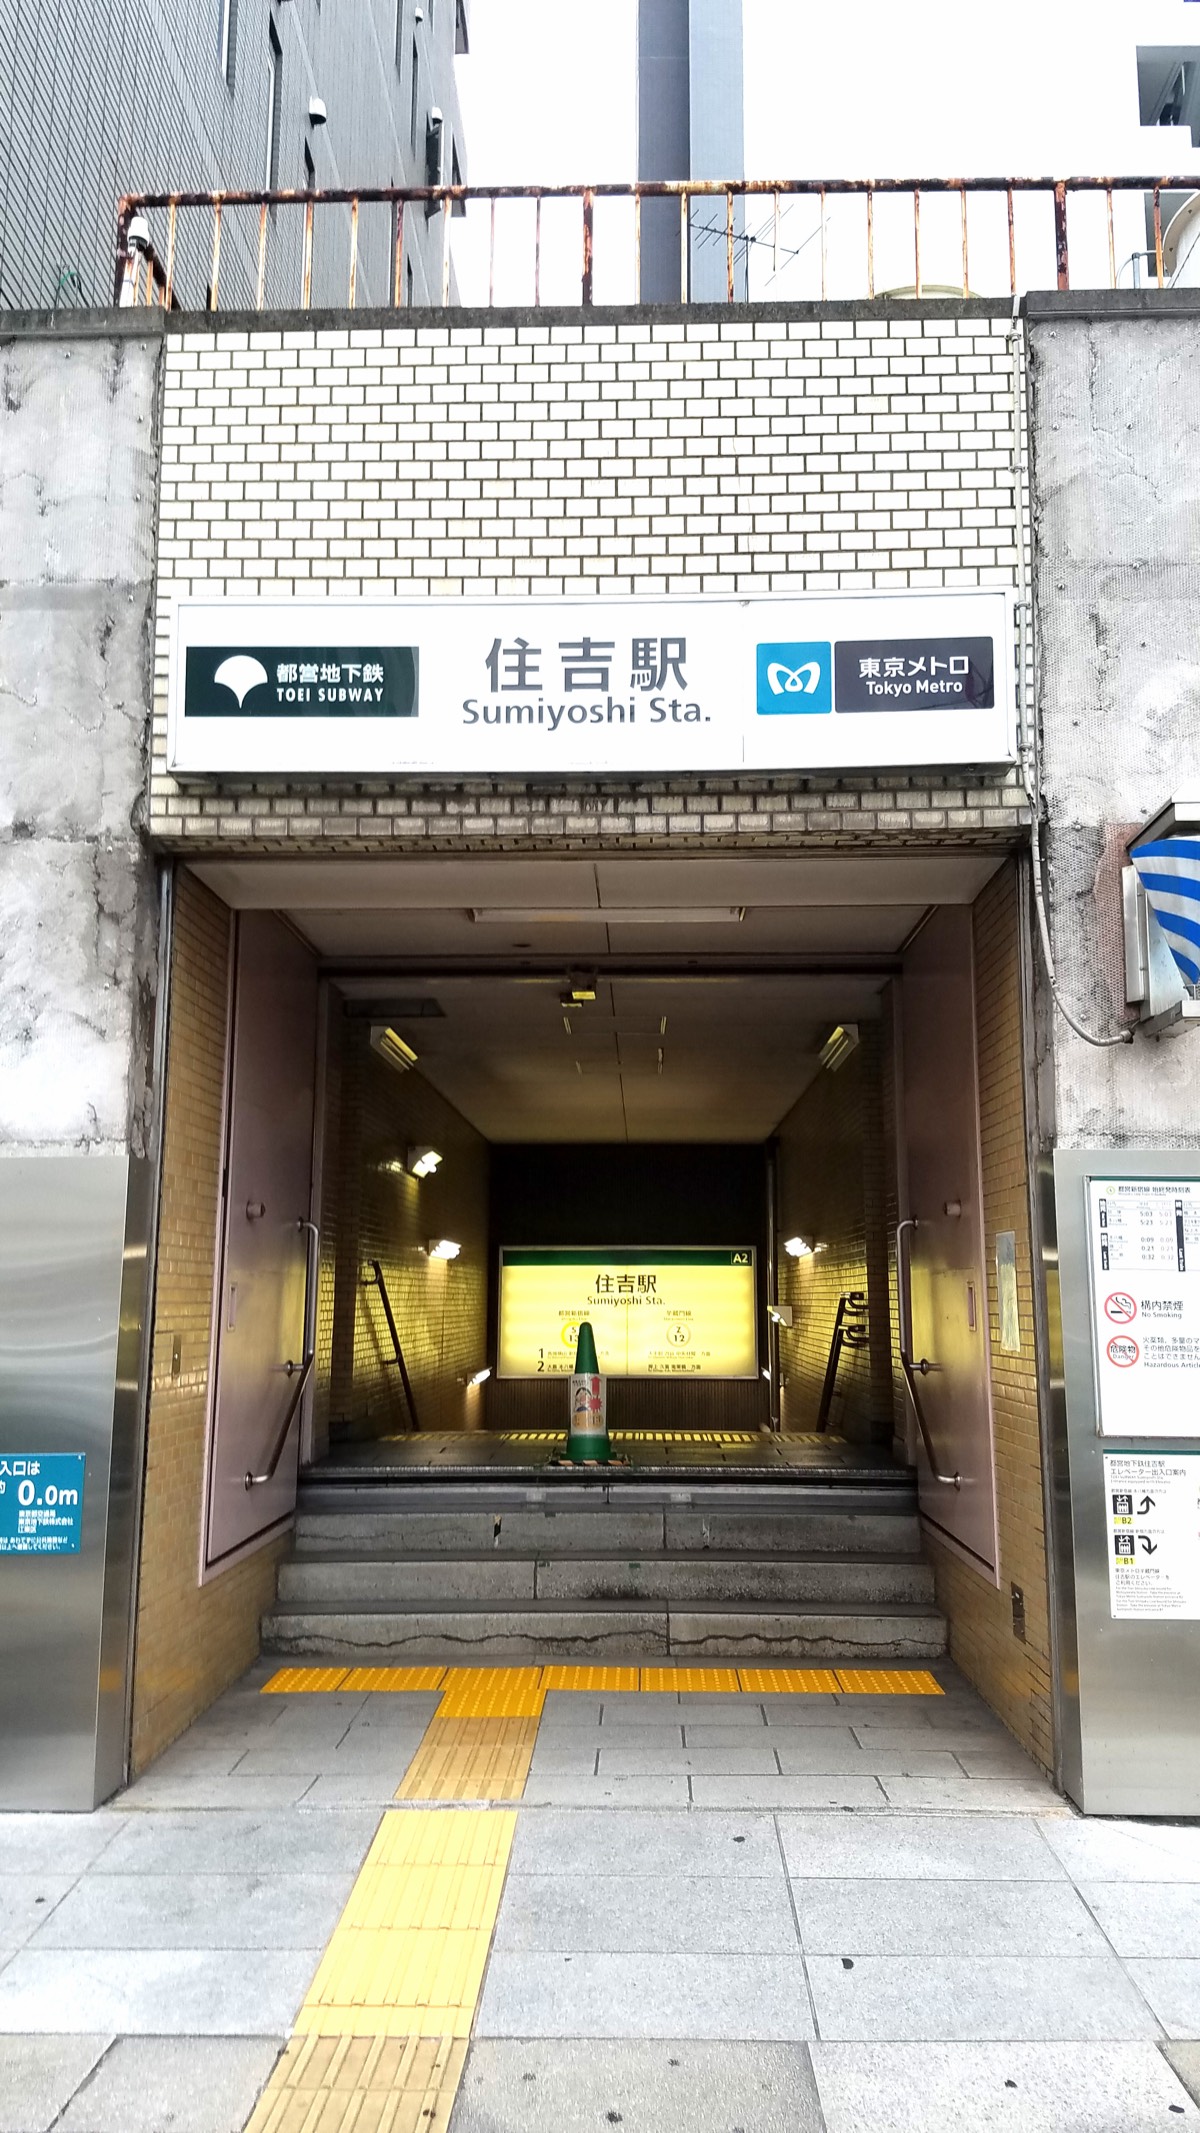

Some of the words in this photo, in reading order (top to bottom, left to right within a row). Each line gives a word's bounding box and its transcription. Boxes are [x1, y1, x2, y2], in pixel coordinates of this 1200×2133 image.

[276, 662, 385, 684] 都営地下鉄
[485, 637, 688, 693] 住吉駅
[858, 656, 969, 678] 東京メトロ
[276, 687, 311, 703] TOEI
[318, 687, 384, 703] SUBWAY
[866, 680, 912, 698] Tokyo
[916, 678, 963, 694] Metro
[462, 696, 636, 731] Sumiyoshi
[649, 697, 712, 723] Sta.
[733, 1253, 748, 1263] A2
[595, 1274, 656, 1294] 住吉駅
[587, 1295, 642, 1307] Sumiyoshi
[646, 1296, 666, 1305] Sta.
[1141, 1300, 1183, 1311] 構内禁煙
[538, 1348, 544, 1358] 1
[1110, 1345, 1136, 1354] 危険物
[537, 1361, 544, 1372] 2
[18, 1480, 78, 1506] 0.0m
